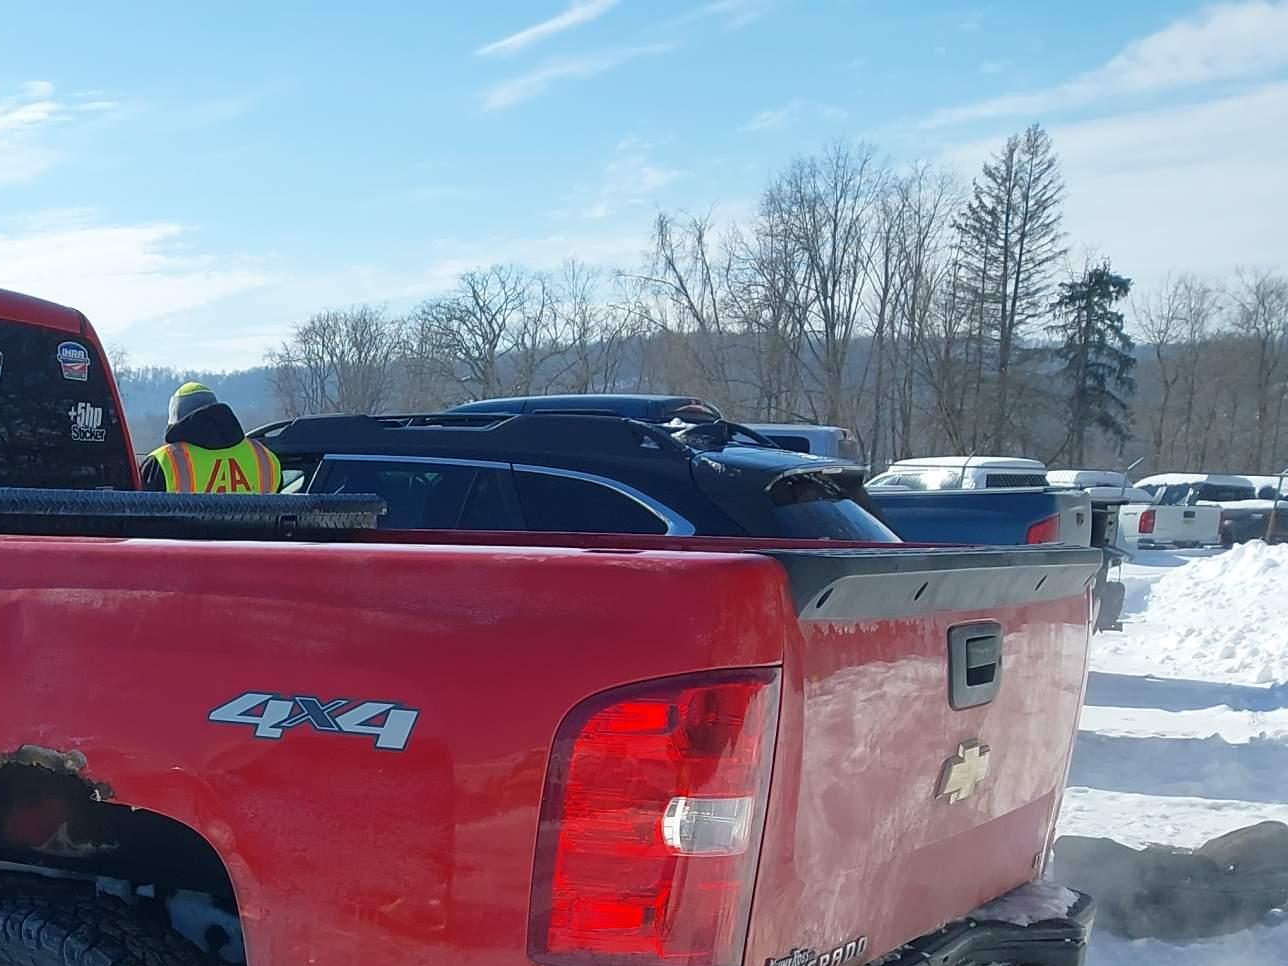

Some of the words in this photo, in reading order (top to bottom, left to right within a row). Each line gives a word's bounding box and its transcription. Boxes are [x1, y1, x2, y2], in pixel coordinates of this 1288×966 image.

[61, 347, 85, 359] IHRA
[68, 402, 102, 429] +5hp
[72, 424, 105, 441] Sticker
